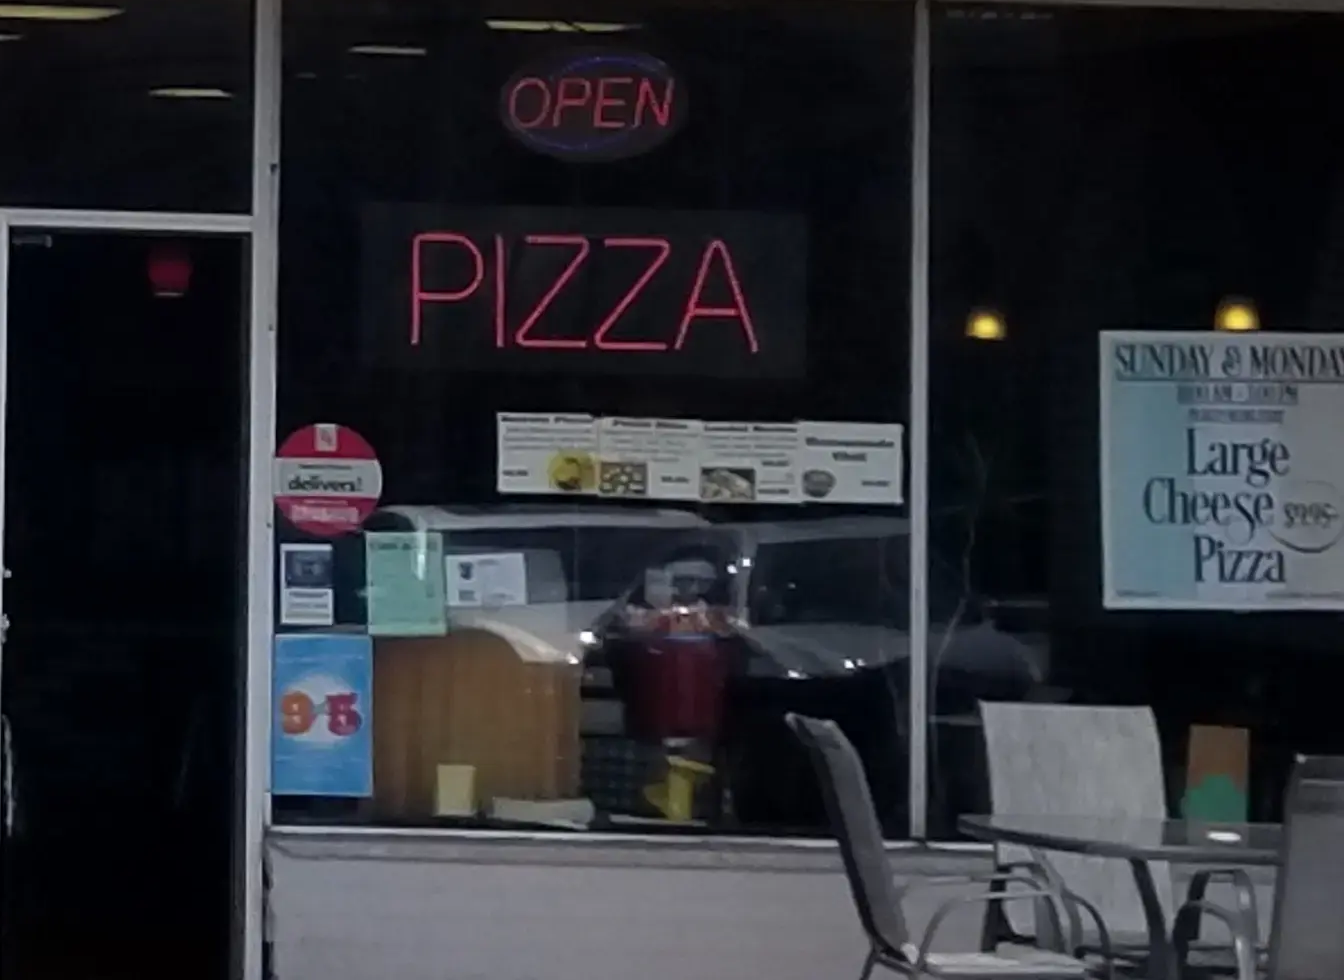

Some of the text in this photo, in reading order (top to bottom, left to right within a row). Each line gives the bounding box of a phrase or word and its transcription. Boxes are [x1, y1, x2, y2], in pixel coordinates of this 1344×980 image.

[508, 75, 676, 129] OPEN
[411, 232, 760, 354] PIZZA
[1114, 343, 1344, 378] SUNDAY & MONDA
[1185, 427, 1291, 489] Large
[1142, 477, 1275, 540] Cheese
[1193, 533, 1287, 584] Pizza
